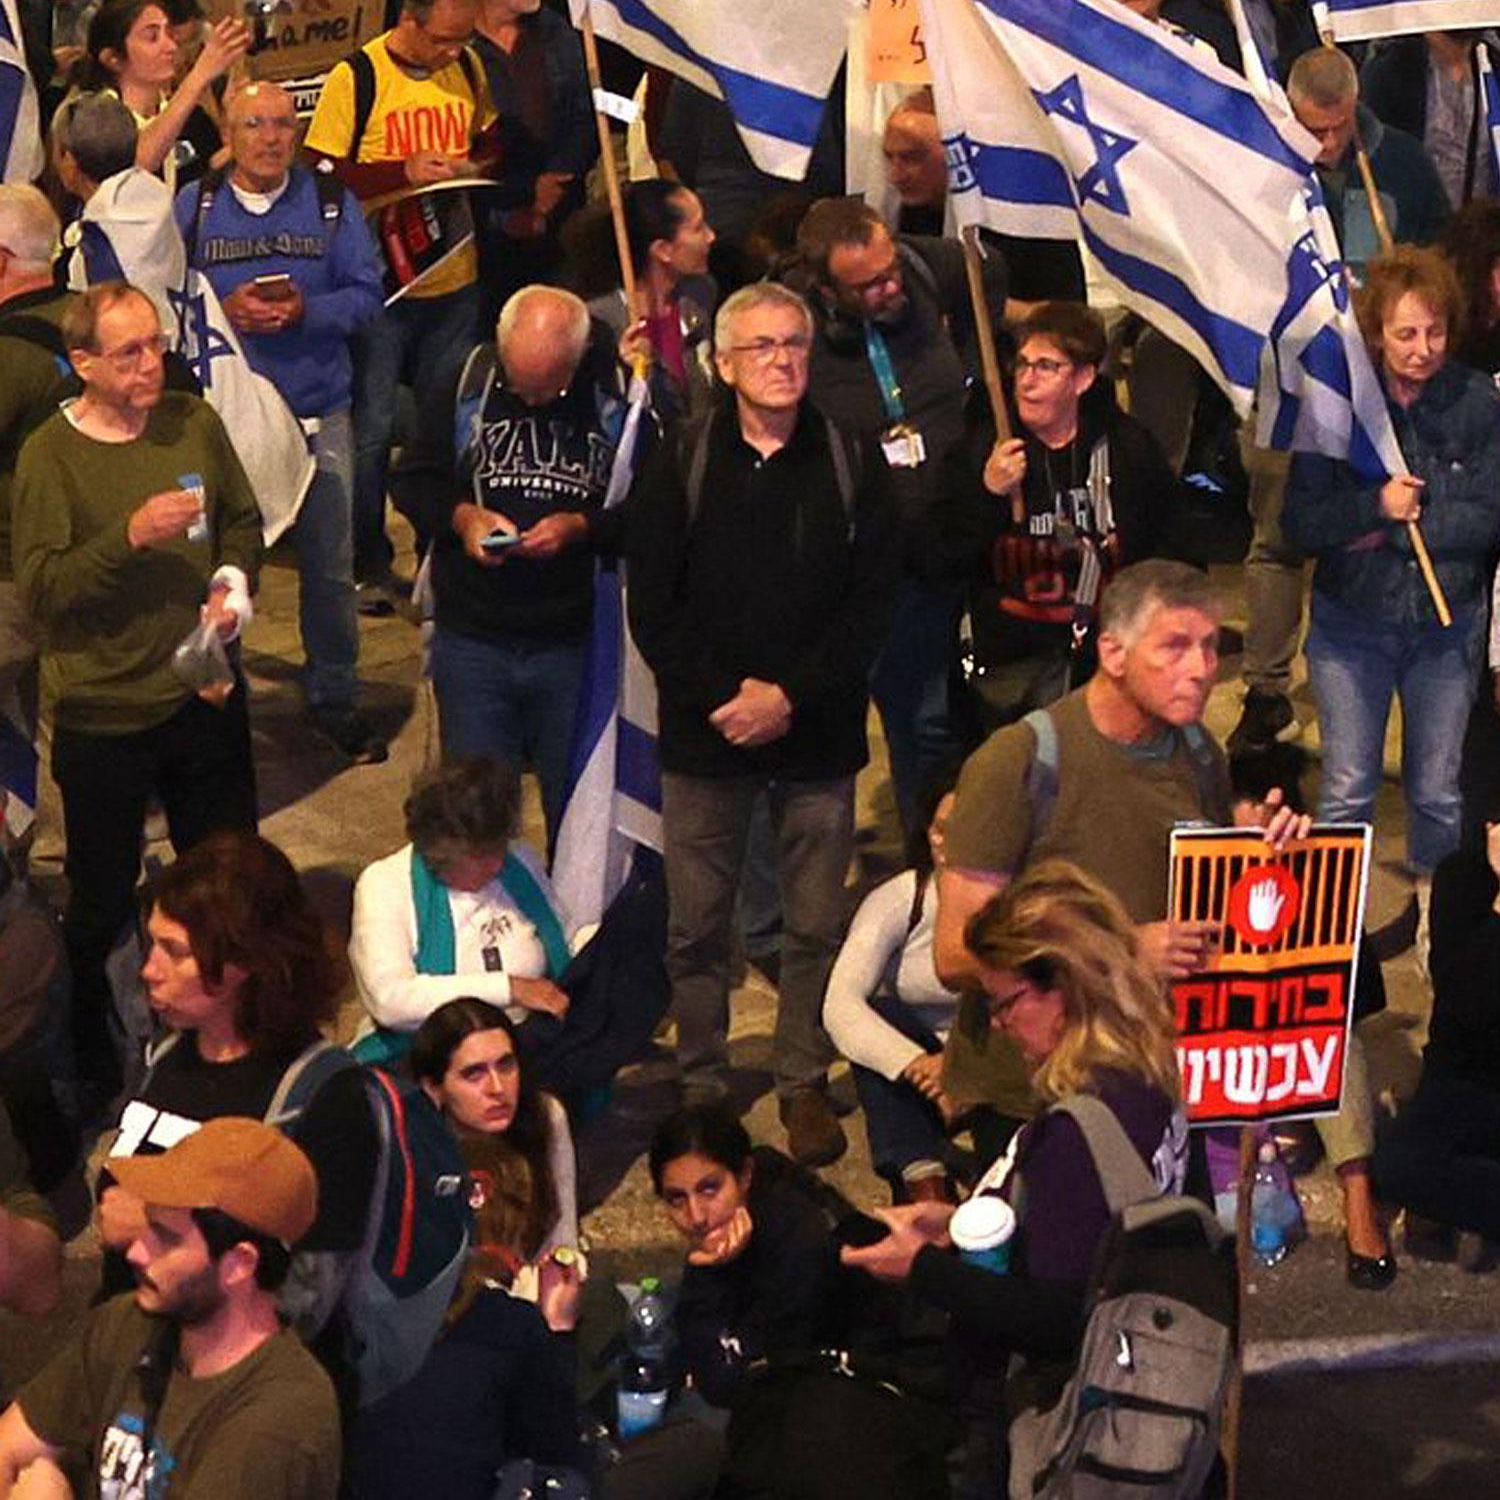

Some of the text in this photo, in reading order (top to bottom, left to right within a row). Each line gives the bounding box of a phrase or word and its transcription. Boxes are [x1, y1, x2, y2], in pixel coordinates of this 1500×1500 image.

[385, 102, 467, 156] NOW
[489, 477, 588, 499] UNIVERSITY
[1172, 972, 1346, 1032] בחירות
